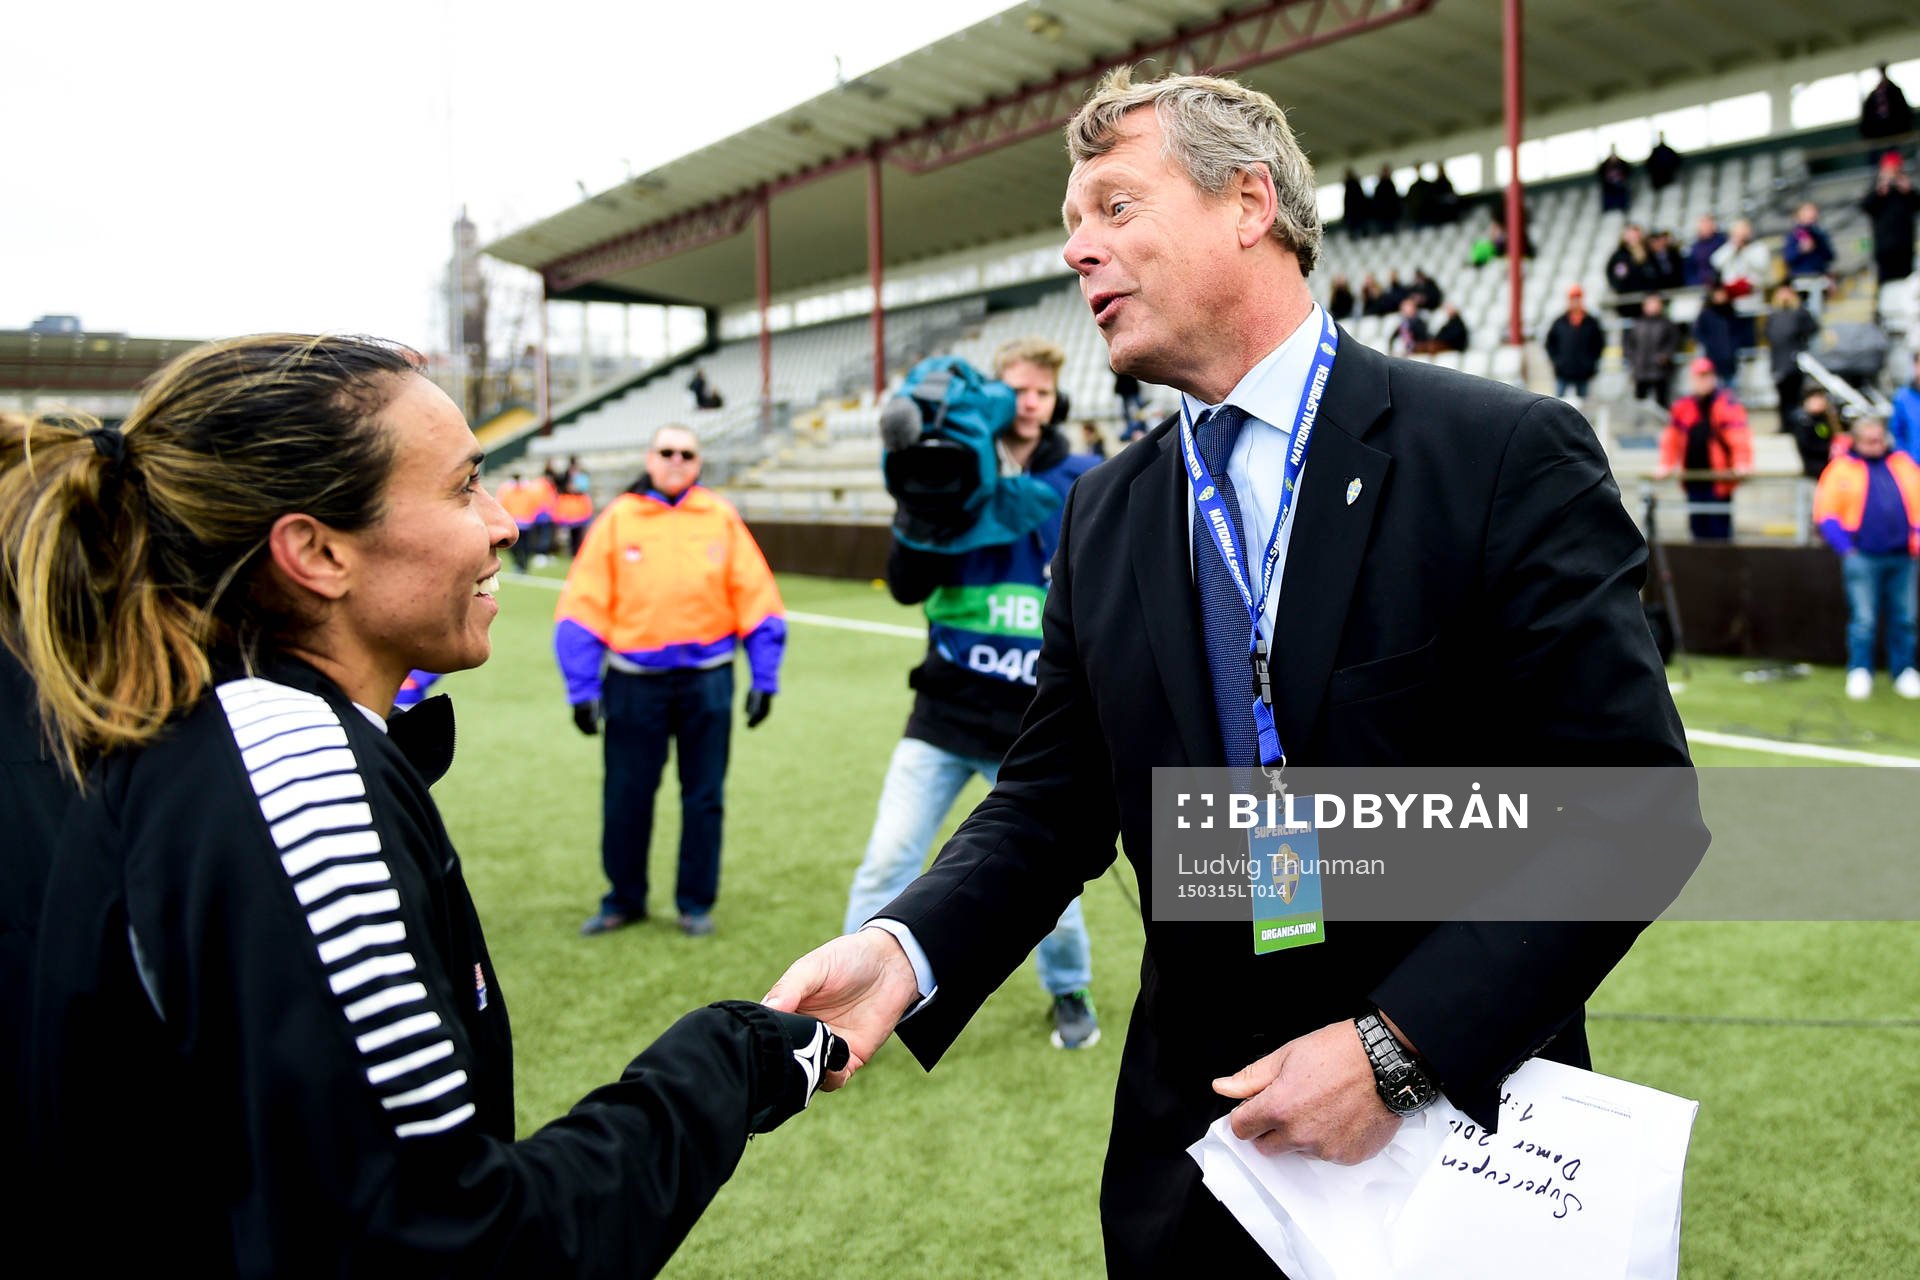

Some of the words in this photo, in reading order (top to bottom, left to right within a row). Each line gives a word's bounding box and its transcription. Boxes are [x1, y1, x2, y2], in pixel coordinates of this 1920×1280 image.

[1290, 364, 1330, 467] NATIONALSPORTEN
[1261, 922, 1317, 941] ORGANISATION
[1441, 1154, 1583, 1219] Supercupen
[1512, 1140, 1581, 1181] Damer
